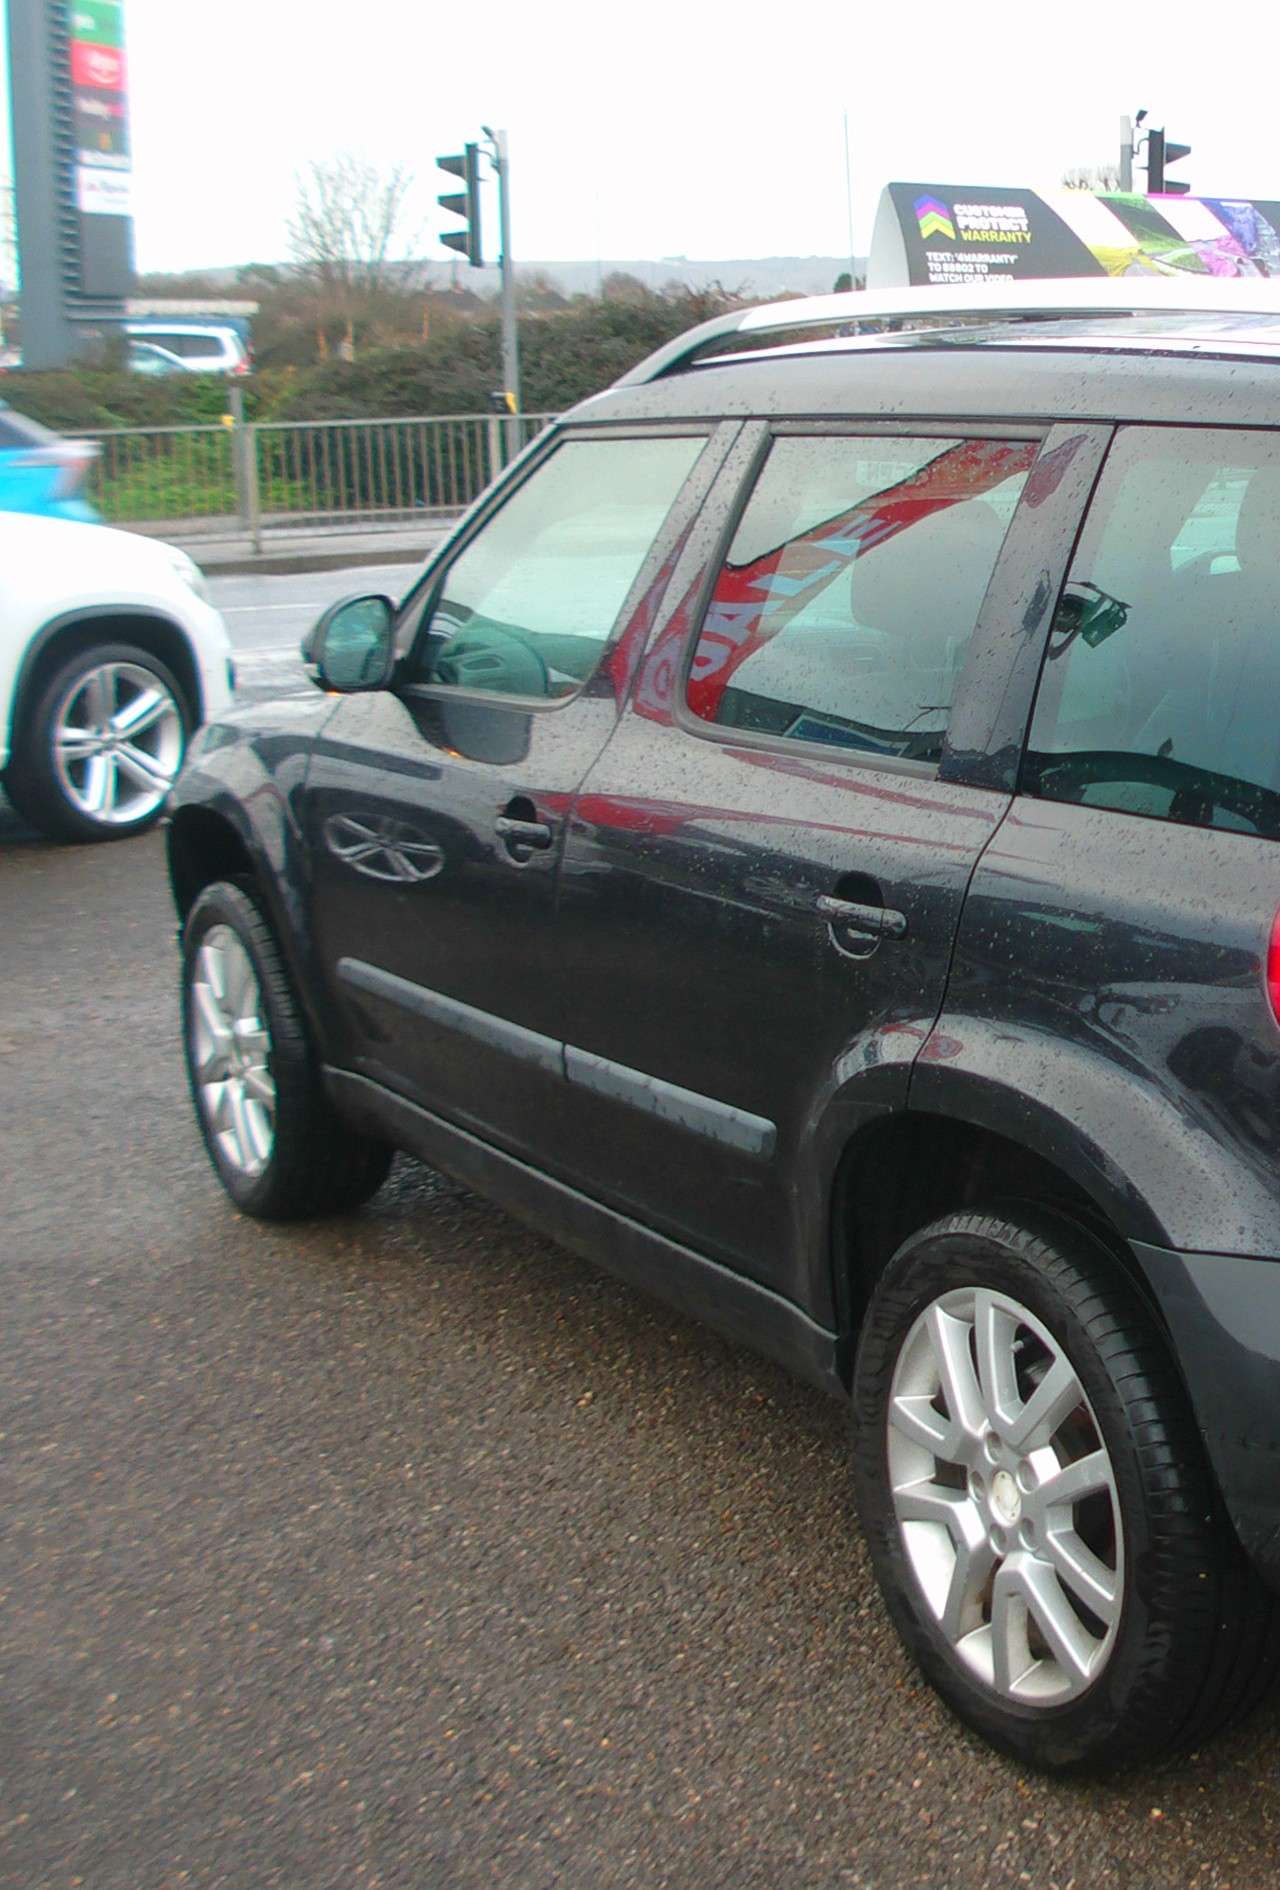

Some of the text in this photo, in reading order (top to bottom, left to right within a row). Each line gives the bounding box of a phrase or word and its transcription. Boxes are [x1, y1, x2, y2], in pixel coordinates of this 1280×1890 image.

[953, 203, 1027, 218] CUSTOMER
[956, 216, 1029, 231] PROTECT
[960, 229, 1032, 244] WARRANTY
[926, 251, 954, 262] TEXT:
[927, 262, 942, 272] TO
[975, 263, 989, 273] TO
[928, 272, 962, 283] WATCH
